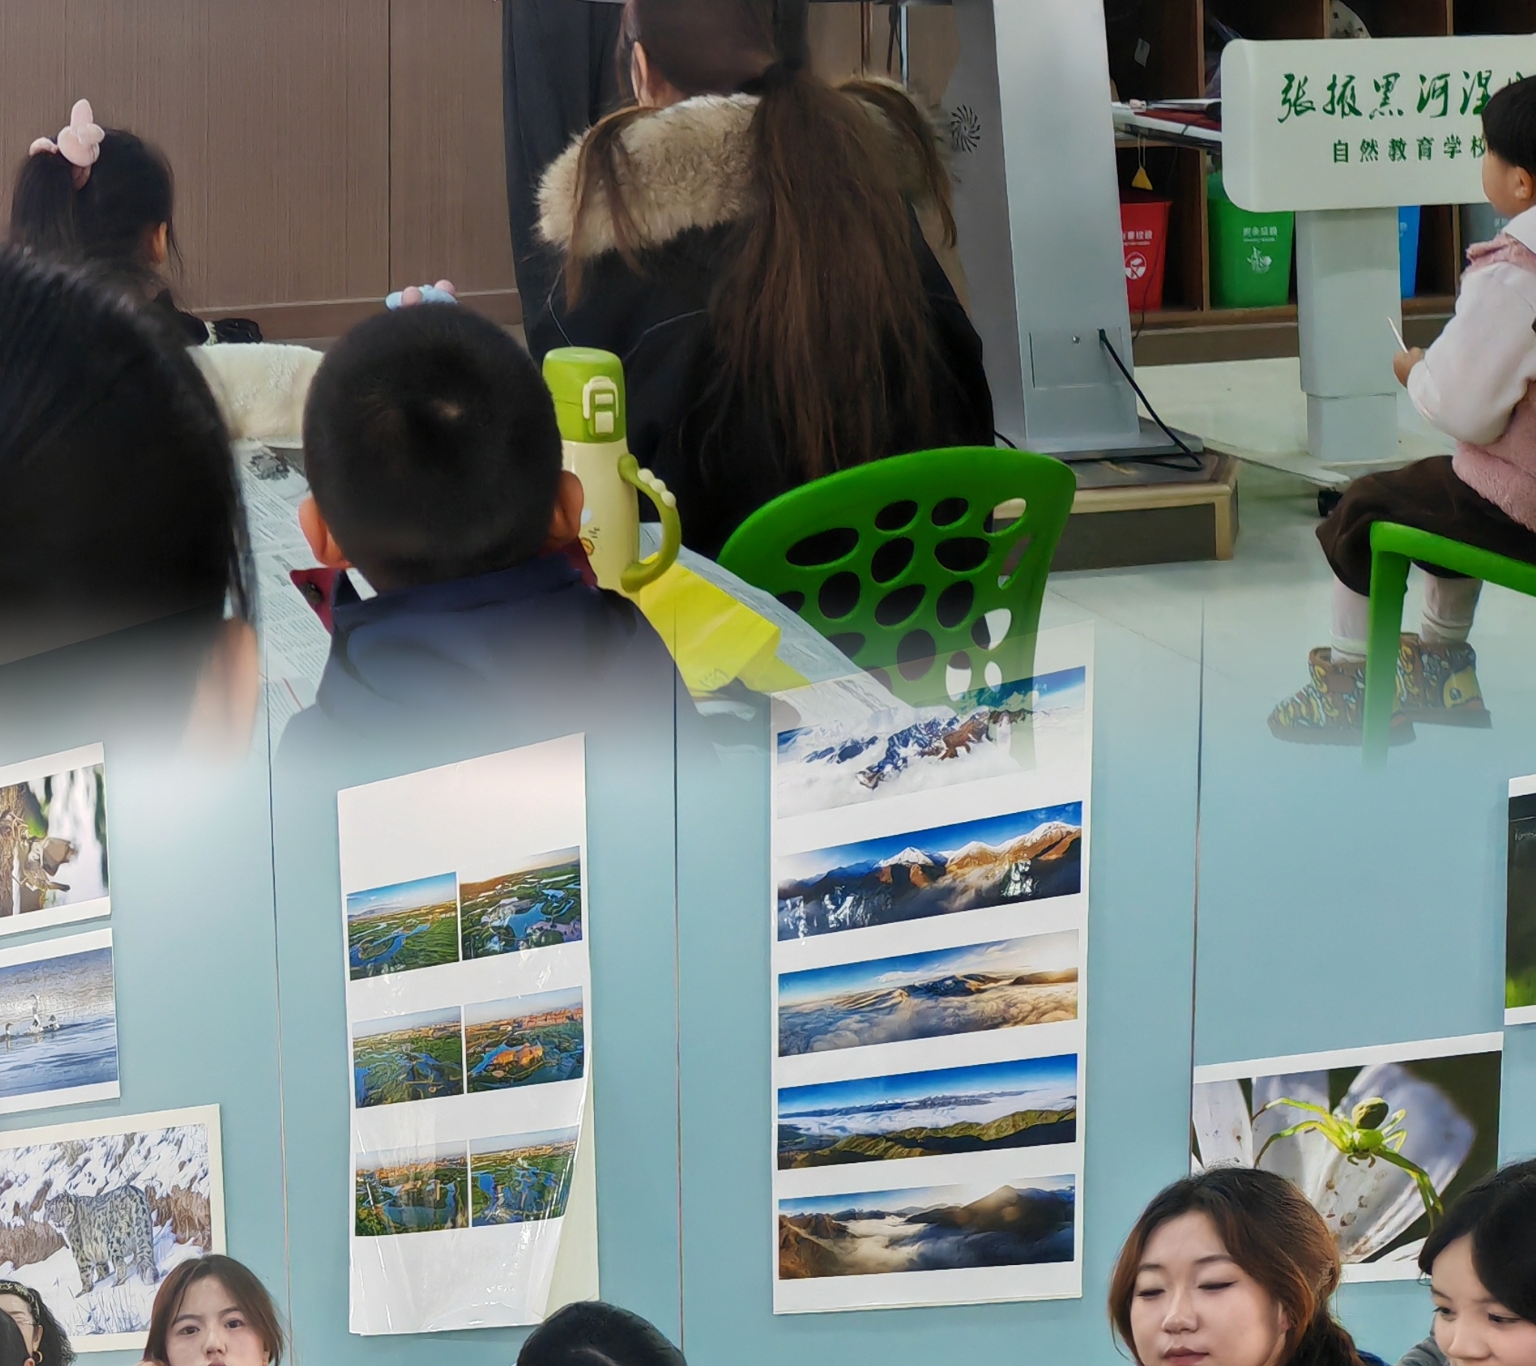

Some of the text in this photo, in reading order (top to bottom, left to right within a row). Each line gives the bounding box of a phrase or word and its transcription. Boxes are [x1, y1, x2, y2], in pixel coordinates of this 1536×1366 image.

[1277, 69, 1528, 124] 张掖黑河湿
